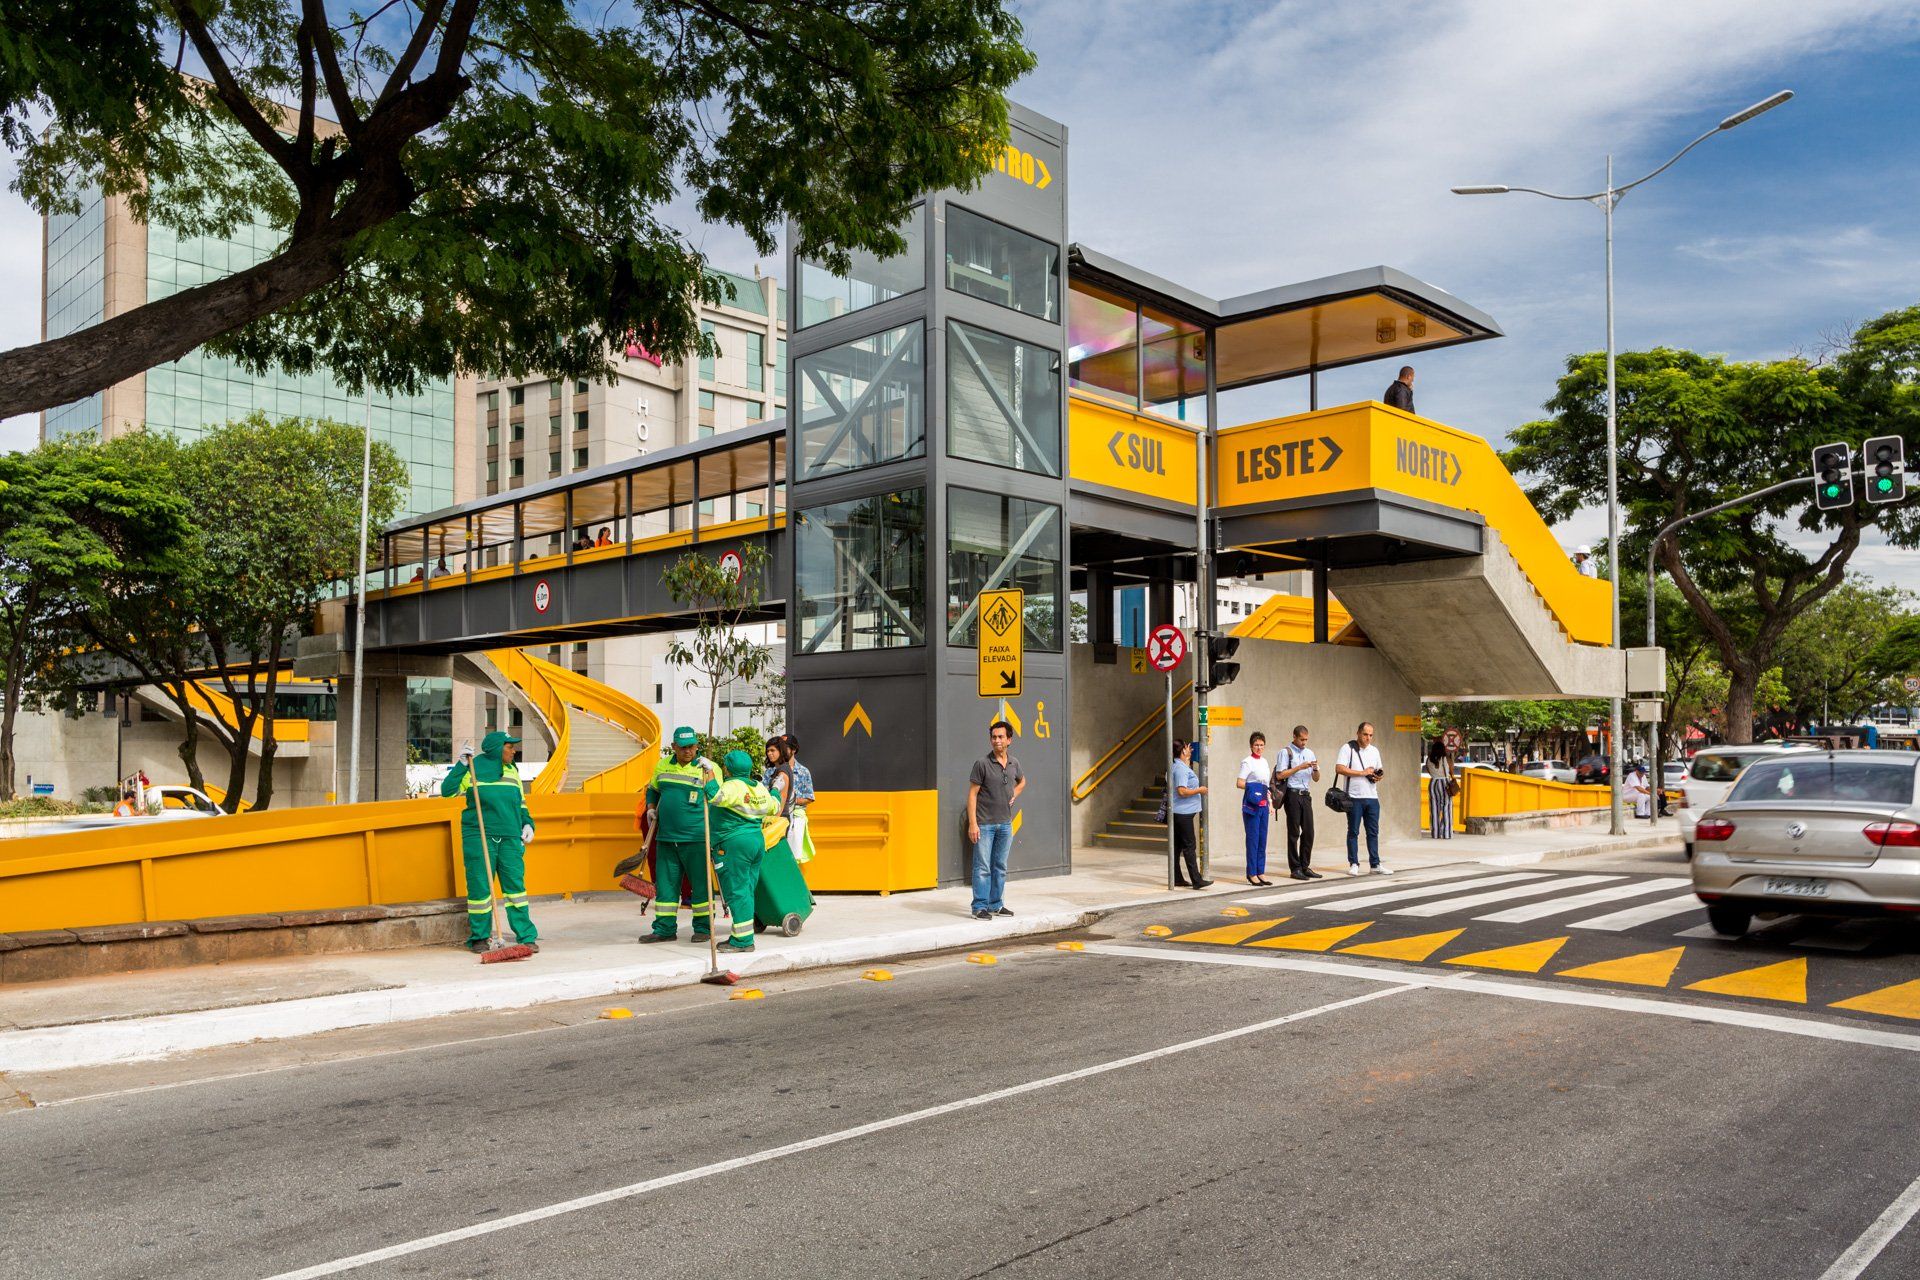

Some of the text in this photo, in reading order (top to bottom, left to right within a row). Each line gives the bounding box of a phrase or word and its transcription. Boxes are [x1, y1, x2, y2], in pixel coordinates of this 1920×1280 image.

[1127, 433, 1166, 476] SUL
[1236, 438, 1315, 484] LESTE
[1396, 437, 1449, 480] NORTE
[983, 654, 1017, 663] ELEVADA
[988, 645, 1010, 653] FAIXA
